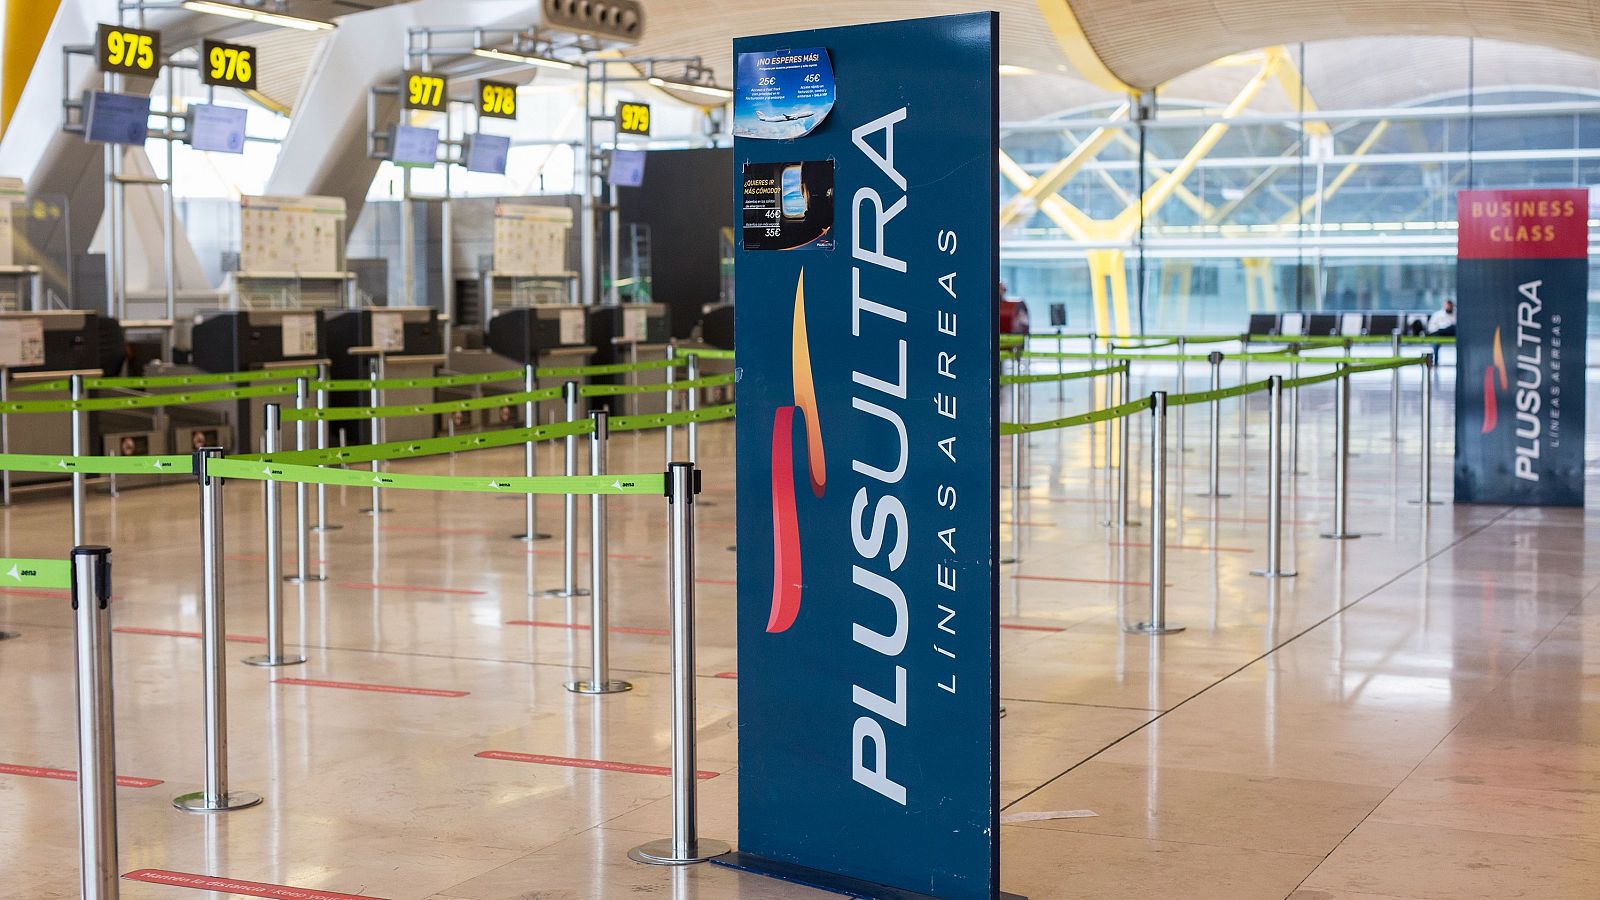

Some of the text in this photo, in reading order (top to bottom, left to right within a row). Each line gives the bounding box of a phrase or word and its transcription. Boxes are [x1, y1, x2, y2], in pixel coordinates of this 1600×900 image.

[107, 30, 154, 70] 975
[771, 55, 802, 65] ESPERES
[209, 46, 252, 83] 976
[758, 77, 776, 86] 25€
[804, 73, 821, 83] 45€
[408, 74, 445, 107] 977
[482, 84, 515, 115] 978
[621, 103, 650, 132] 979
[765, 209, 781, 219] 46€
[1471, 200, 1575, 218] BUSINESS
[765, 228, 781, 237] 35€
[1489, 225, 1556, 242] CLASS
[1514, 280, 1543, 482] PLUSULTRA
[851, 106, 908, 806] PLUSULTRA
[933, 229, 957, 694] LÍNEAS AÉREAS
[206, 879, 267, 893] distancia
